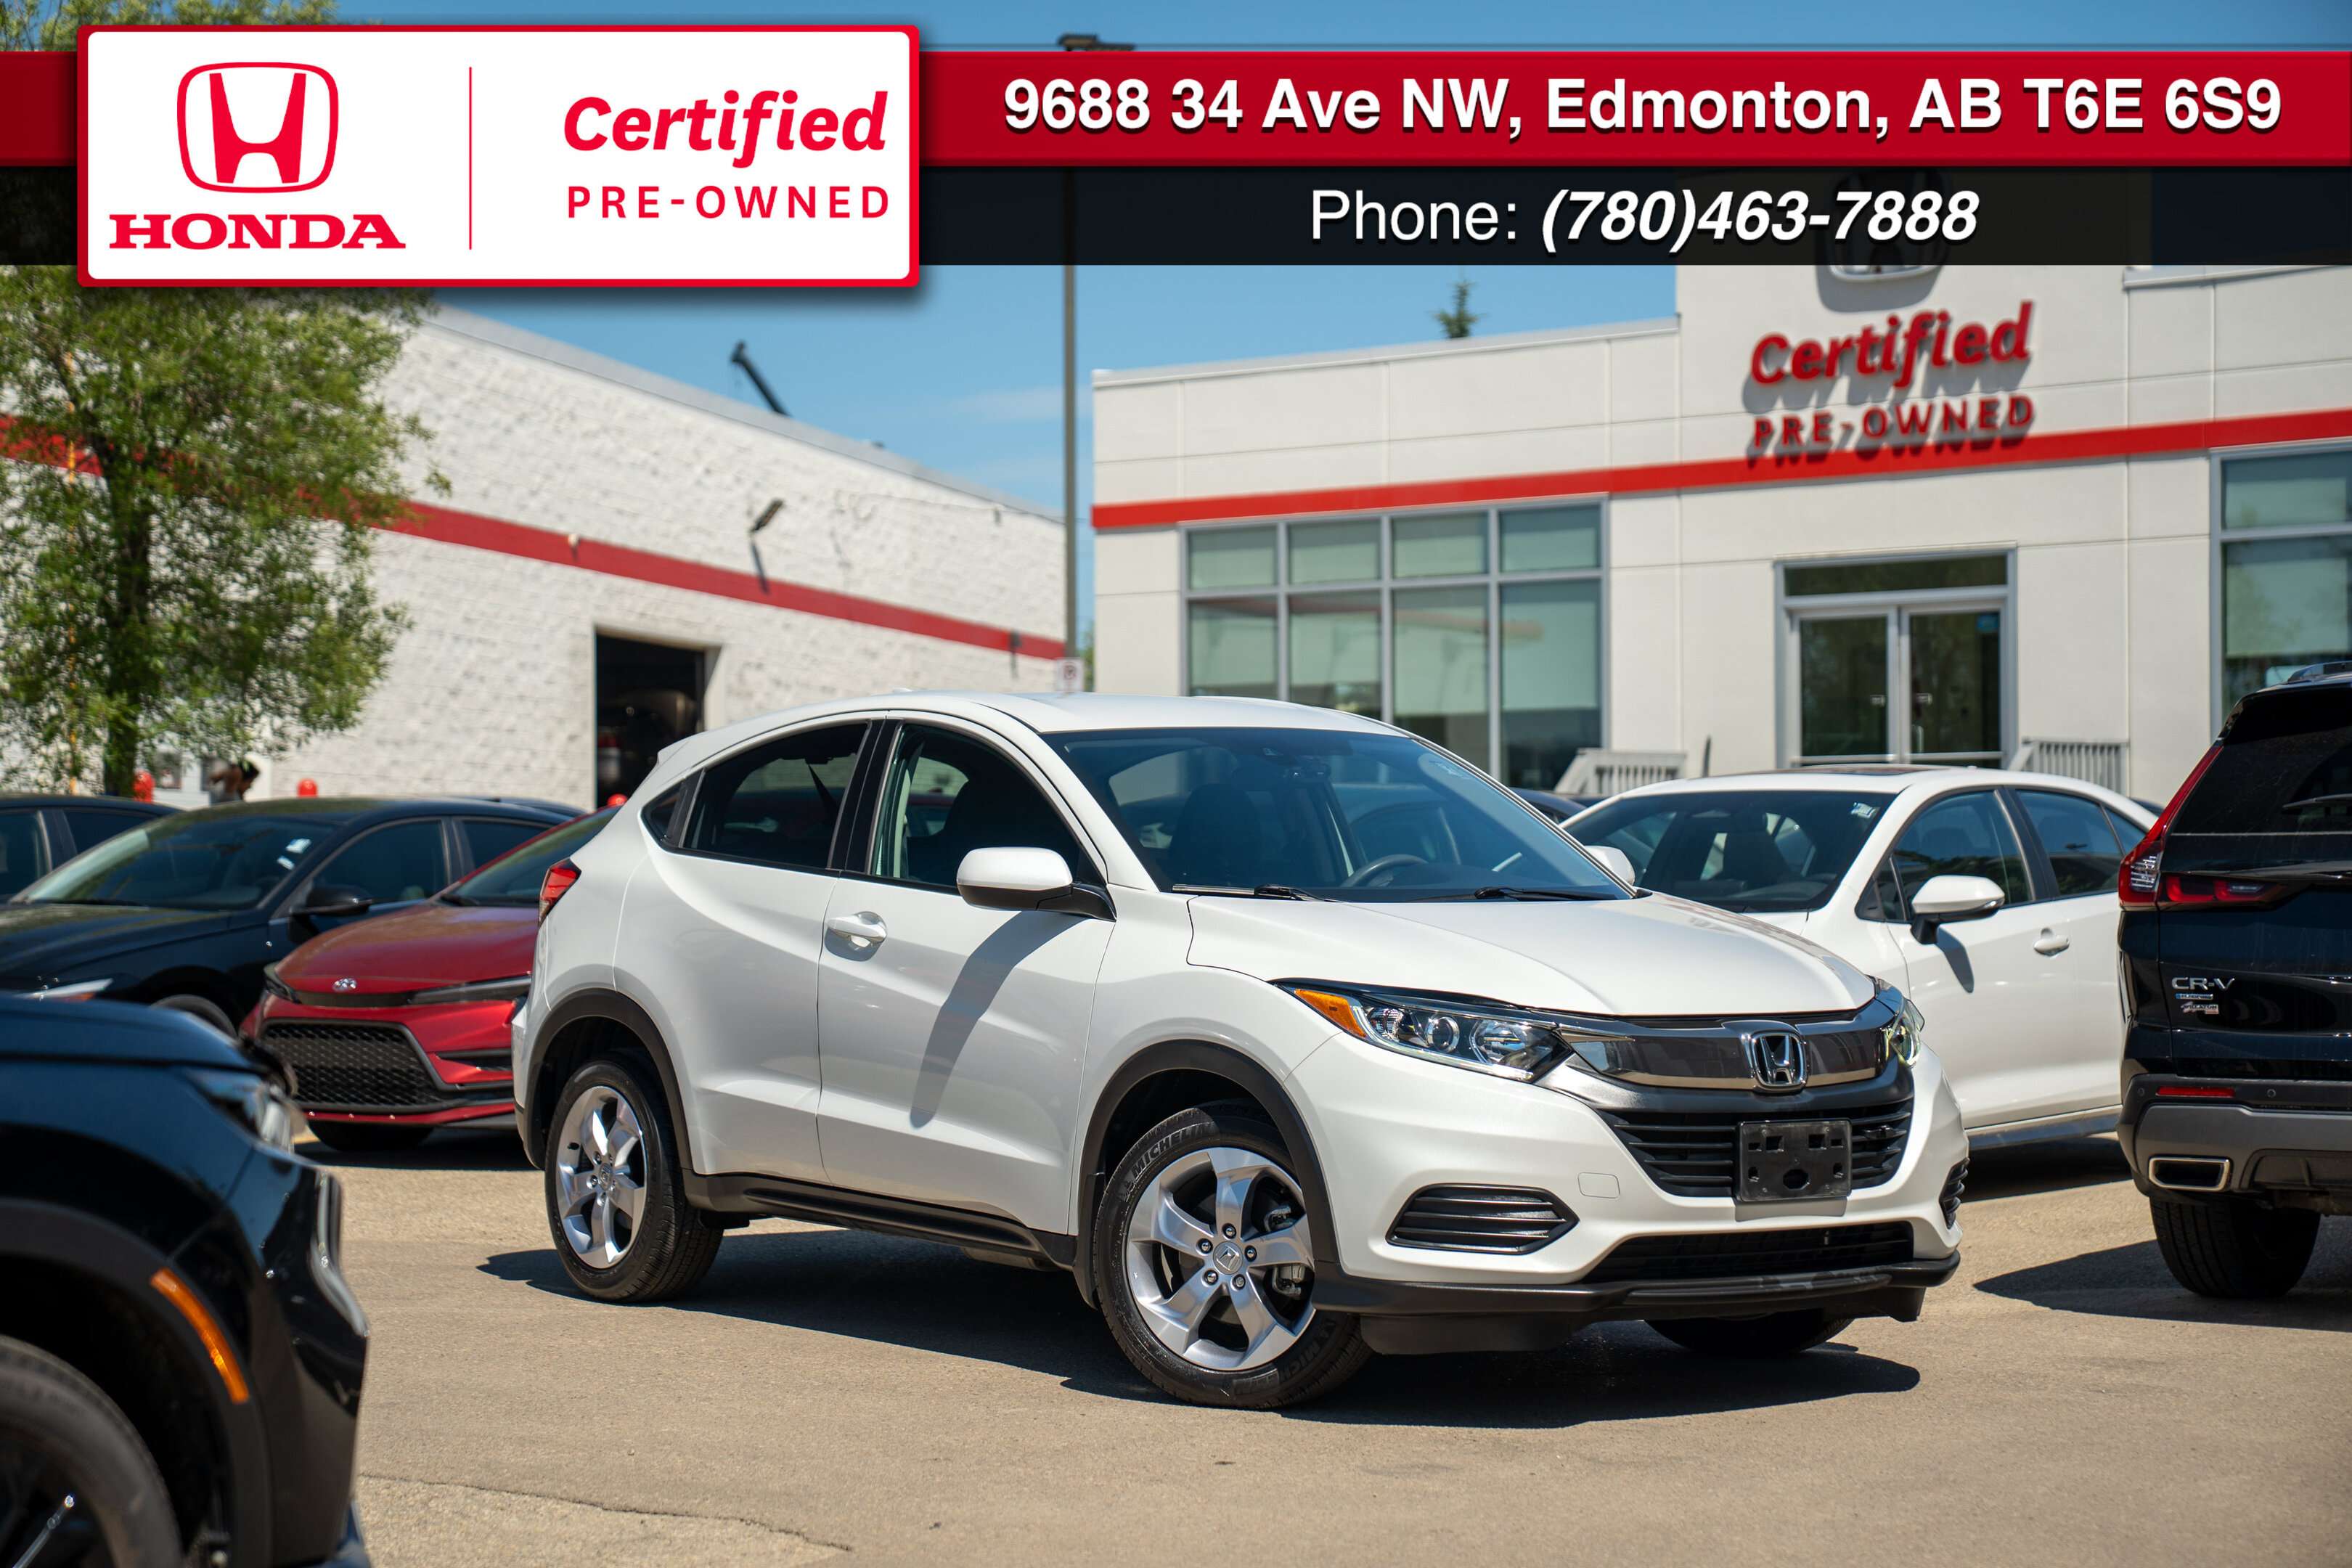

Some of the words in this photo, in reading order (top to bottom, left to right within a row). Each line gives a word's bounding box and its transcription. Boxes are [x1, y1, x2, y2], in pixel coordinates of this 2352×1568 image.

[1749, 300, 2033, 390] Certified
[1753, 395, 2033, 448] PRE-OWNED
[2171, 976, 2235, 992] CR-V
[1130, 1122, 1206, 1178] MICHELIN
